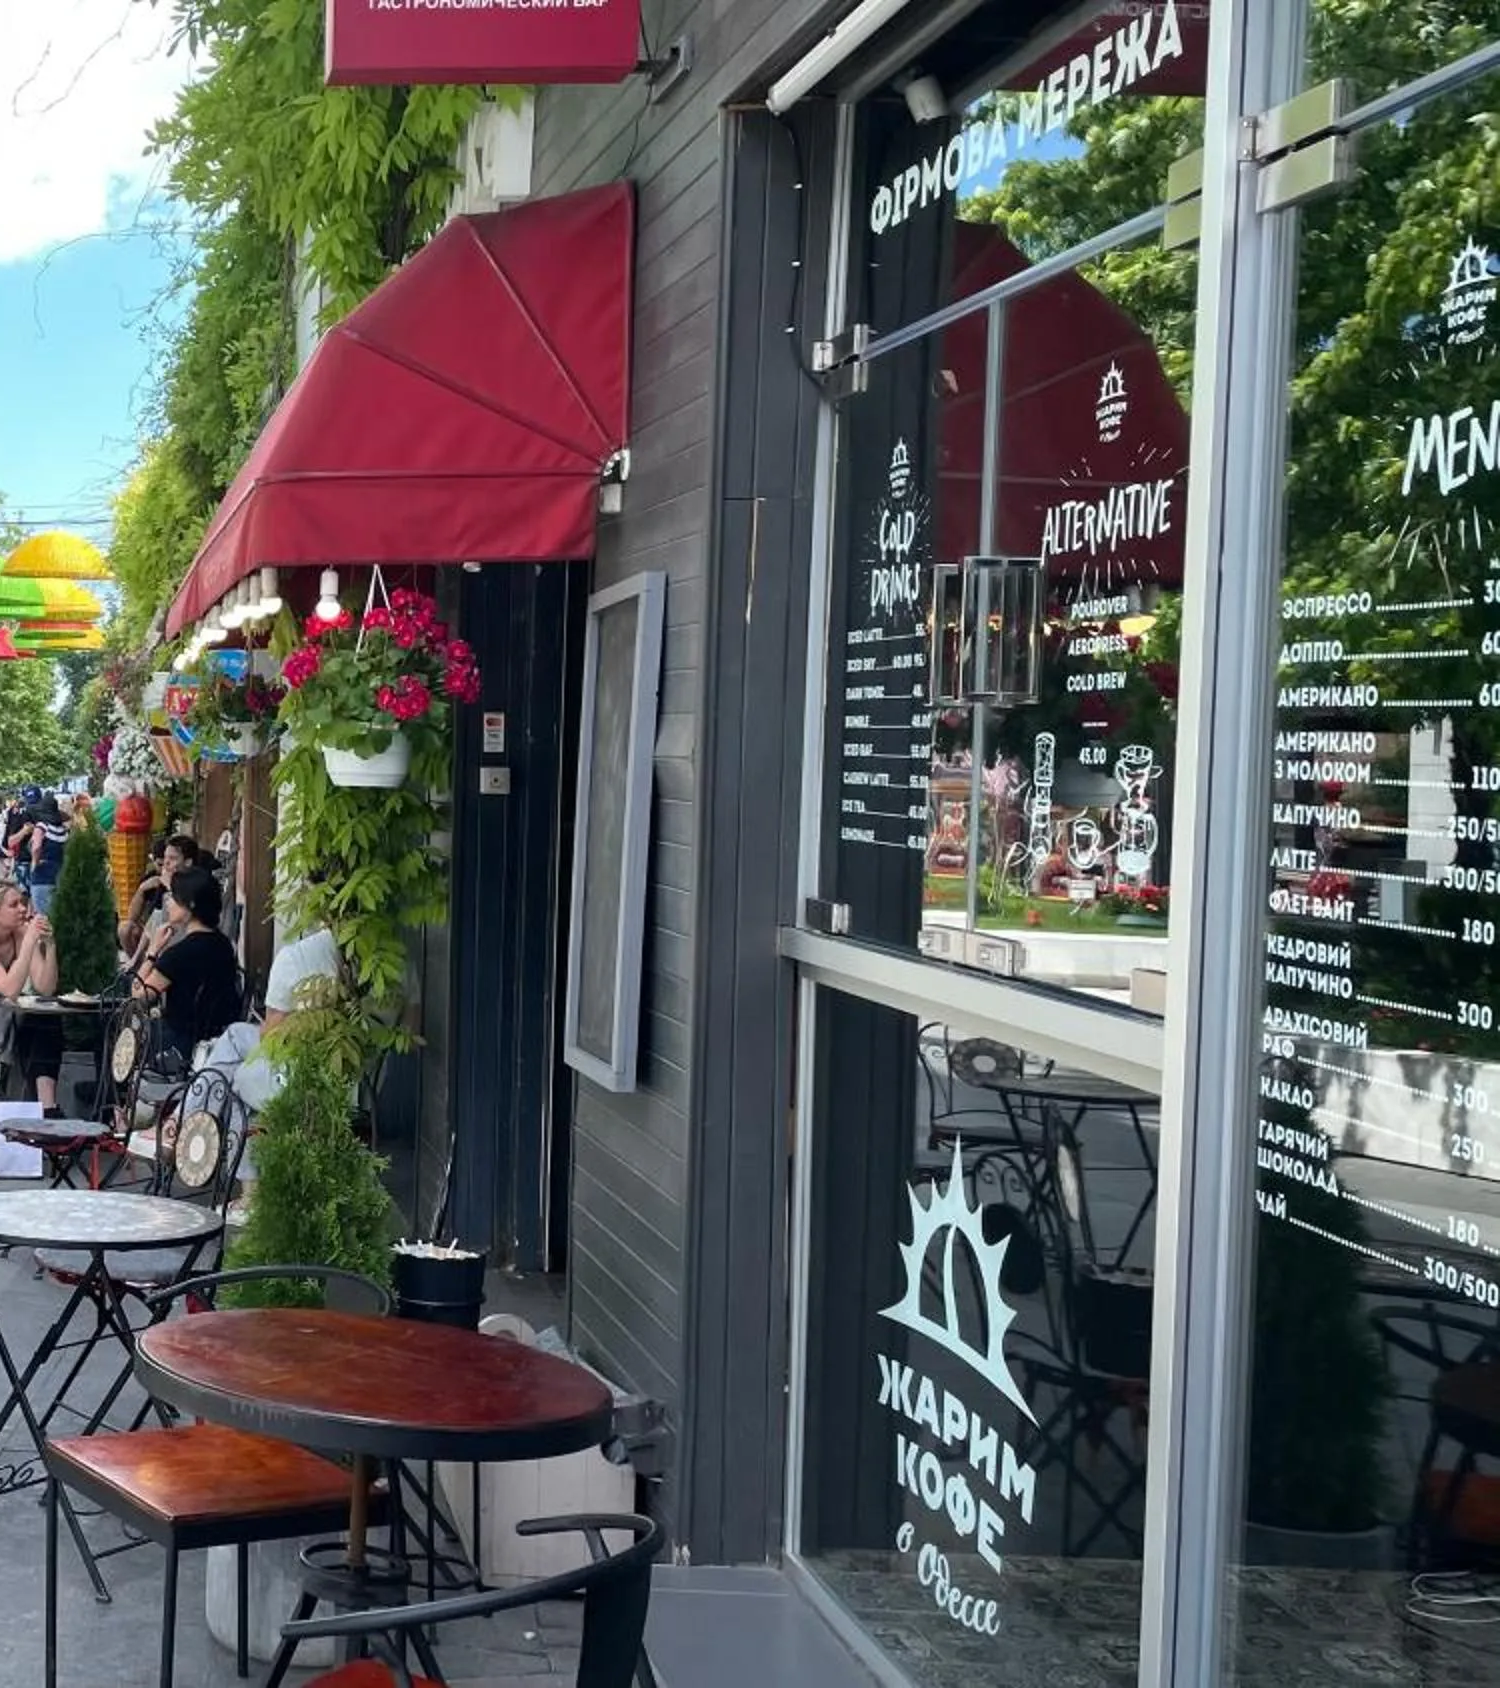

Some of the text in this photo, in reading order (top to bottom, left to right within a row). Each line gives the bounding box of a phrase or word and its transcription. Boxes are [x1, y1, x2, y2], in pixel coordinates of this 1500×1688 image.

[871, 0, 1183, 235] ФІРМОВА МЕРЕЖА
[1447, 306, 1487, 329] КОФЕ
[1402, 400, 1500, 496] MEN
[1041, 478, 1175, 566] ALTERNATIVE
[870, 562, 921, 617] DRINKS
[1071, 595, 1129, 620] POUROVER
[1282, 591, 1372, 619] ЭСПРЕССО
[1068, 633, 1129, 657] AEROPRESS
[1279, 640, 1343, 665] ДОППІО
[1067, 671, 1128, 693] COLD BREW
[1277, 685, 1379, 707] АМЕРИКАНО
[1078, 746, 1108, 766] 45.00
[1275, 731, 1377, 754] АМЕРИКАНО
[1287, 760, 1371, 784] МОЛОКОМ
[1471, 766, 1500, 791] 110
[1272, 803, 1500, 842] КАПУЧИНО 250/5
[1269, 847, 1500, 894] ЛАТТЕ 300/5
[1267, 933, 1351, 969] КЕДРОВИЙ
[1462, 917, 1495, 945] 180
[1265, 961, 1493, 1030] КАПУЧИНО 300
[1262, 1033, 1488, 1113] РАФ 300
[1259, 1119, 1329, 1161] ГАРЯЧИЙ
[1260, 1076, 1484, 1164] КАКАО 250
[1257, 1146, 1480, 1247] ШОКОЛАД 180
[1256, 1189, 1499, 1307] ЧАЙ 300/500
[877, 1353, 1037, 1526] ЖАРИМ
[897, 1433, 1005, 1575] КОФЕ
[896, 1521, 1001, 1636] в Одессе
